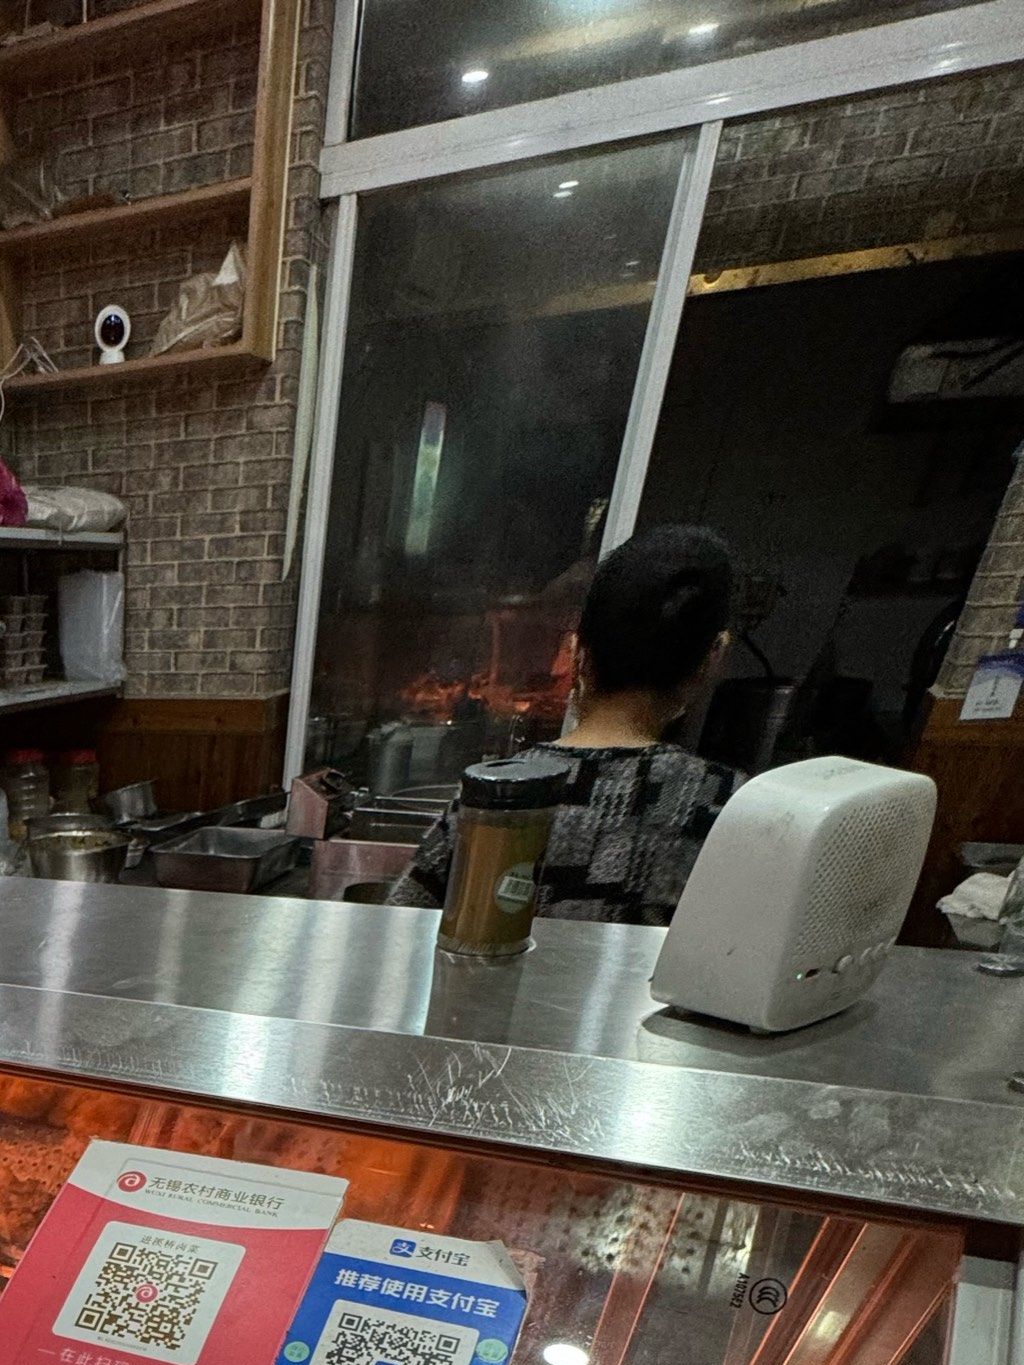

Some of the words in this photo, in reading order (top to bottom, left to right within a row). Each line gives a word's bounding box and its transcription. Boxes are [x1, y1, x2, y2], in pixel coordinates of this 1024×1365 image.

[145, 1189, 166, 1198] WUXI
[168, 1193, 193, 1202] RURAL
[197, 1199, 251, 1213] COMMERCIAL
[254, 1209, 278, 1218] BANK
[149, 1177, 285, 1210] 无锡农村商业银行
[415, 1246, 471, 1267] 支付宝
[334, 1269, 500, 1318] 推荐使用支付宝
